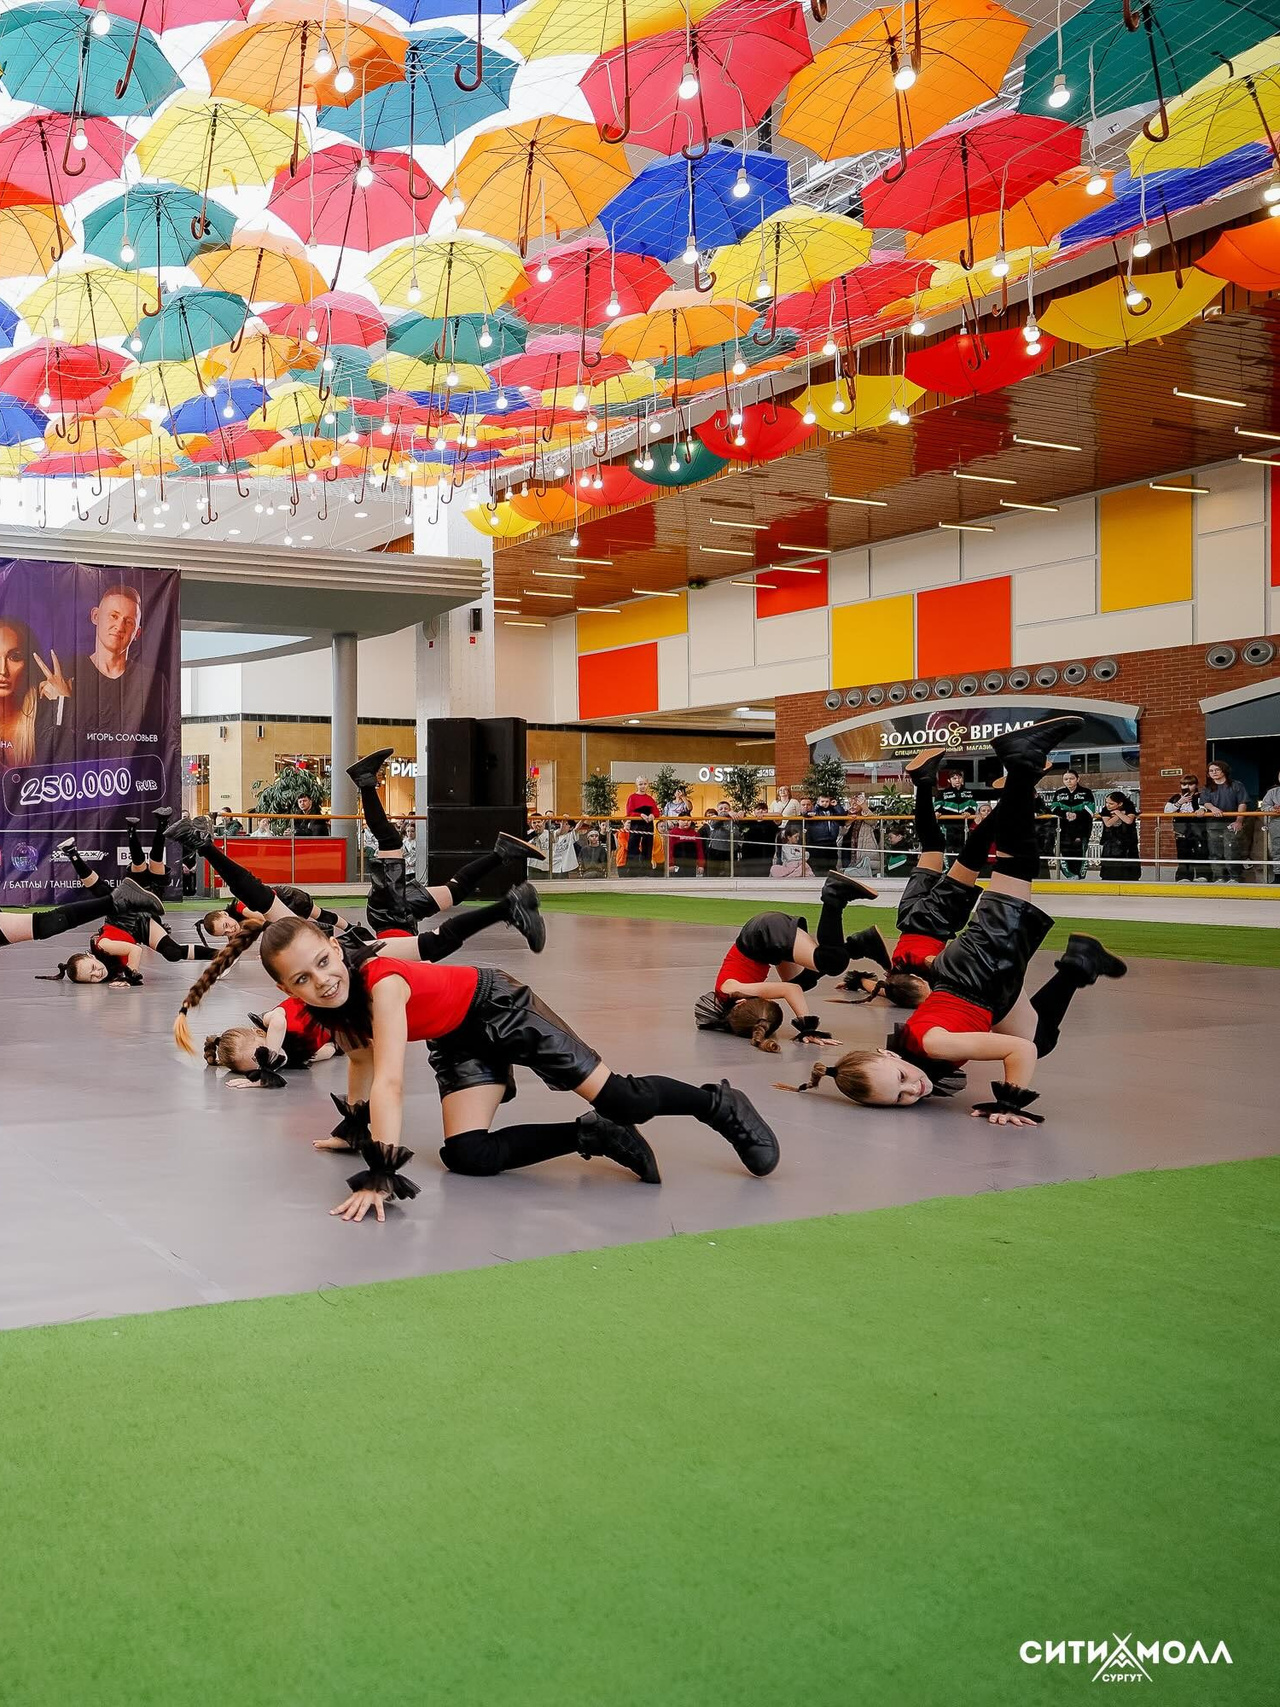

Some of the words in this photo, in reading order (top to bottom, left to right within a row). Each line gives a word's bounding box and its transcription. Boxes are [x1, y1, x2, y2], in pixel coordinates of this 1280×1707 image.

[86, 733, 113, 741] ИГОРЬ
[115, 733, 158, 743] СОЛОВЬЕВ
[880, 729, 949, 746] ЗОЛОТО
[20, 767, 132, 805] 250.000
[9, 881, 42, 889] БАТТЛЫ
